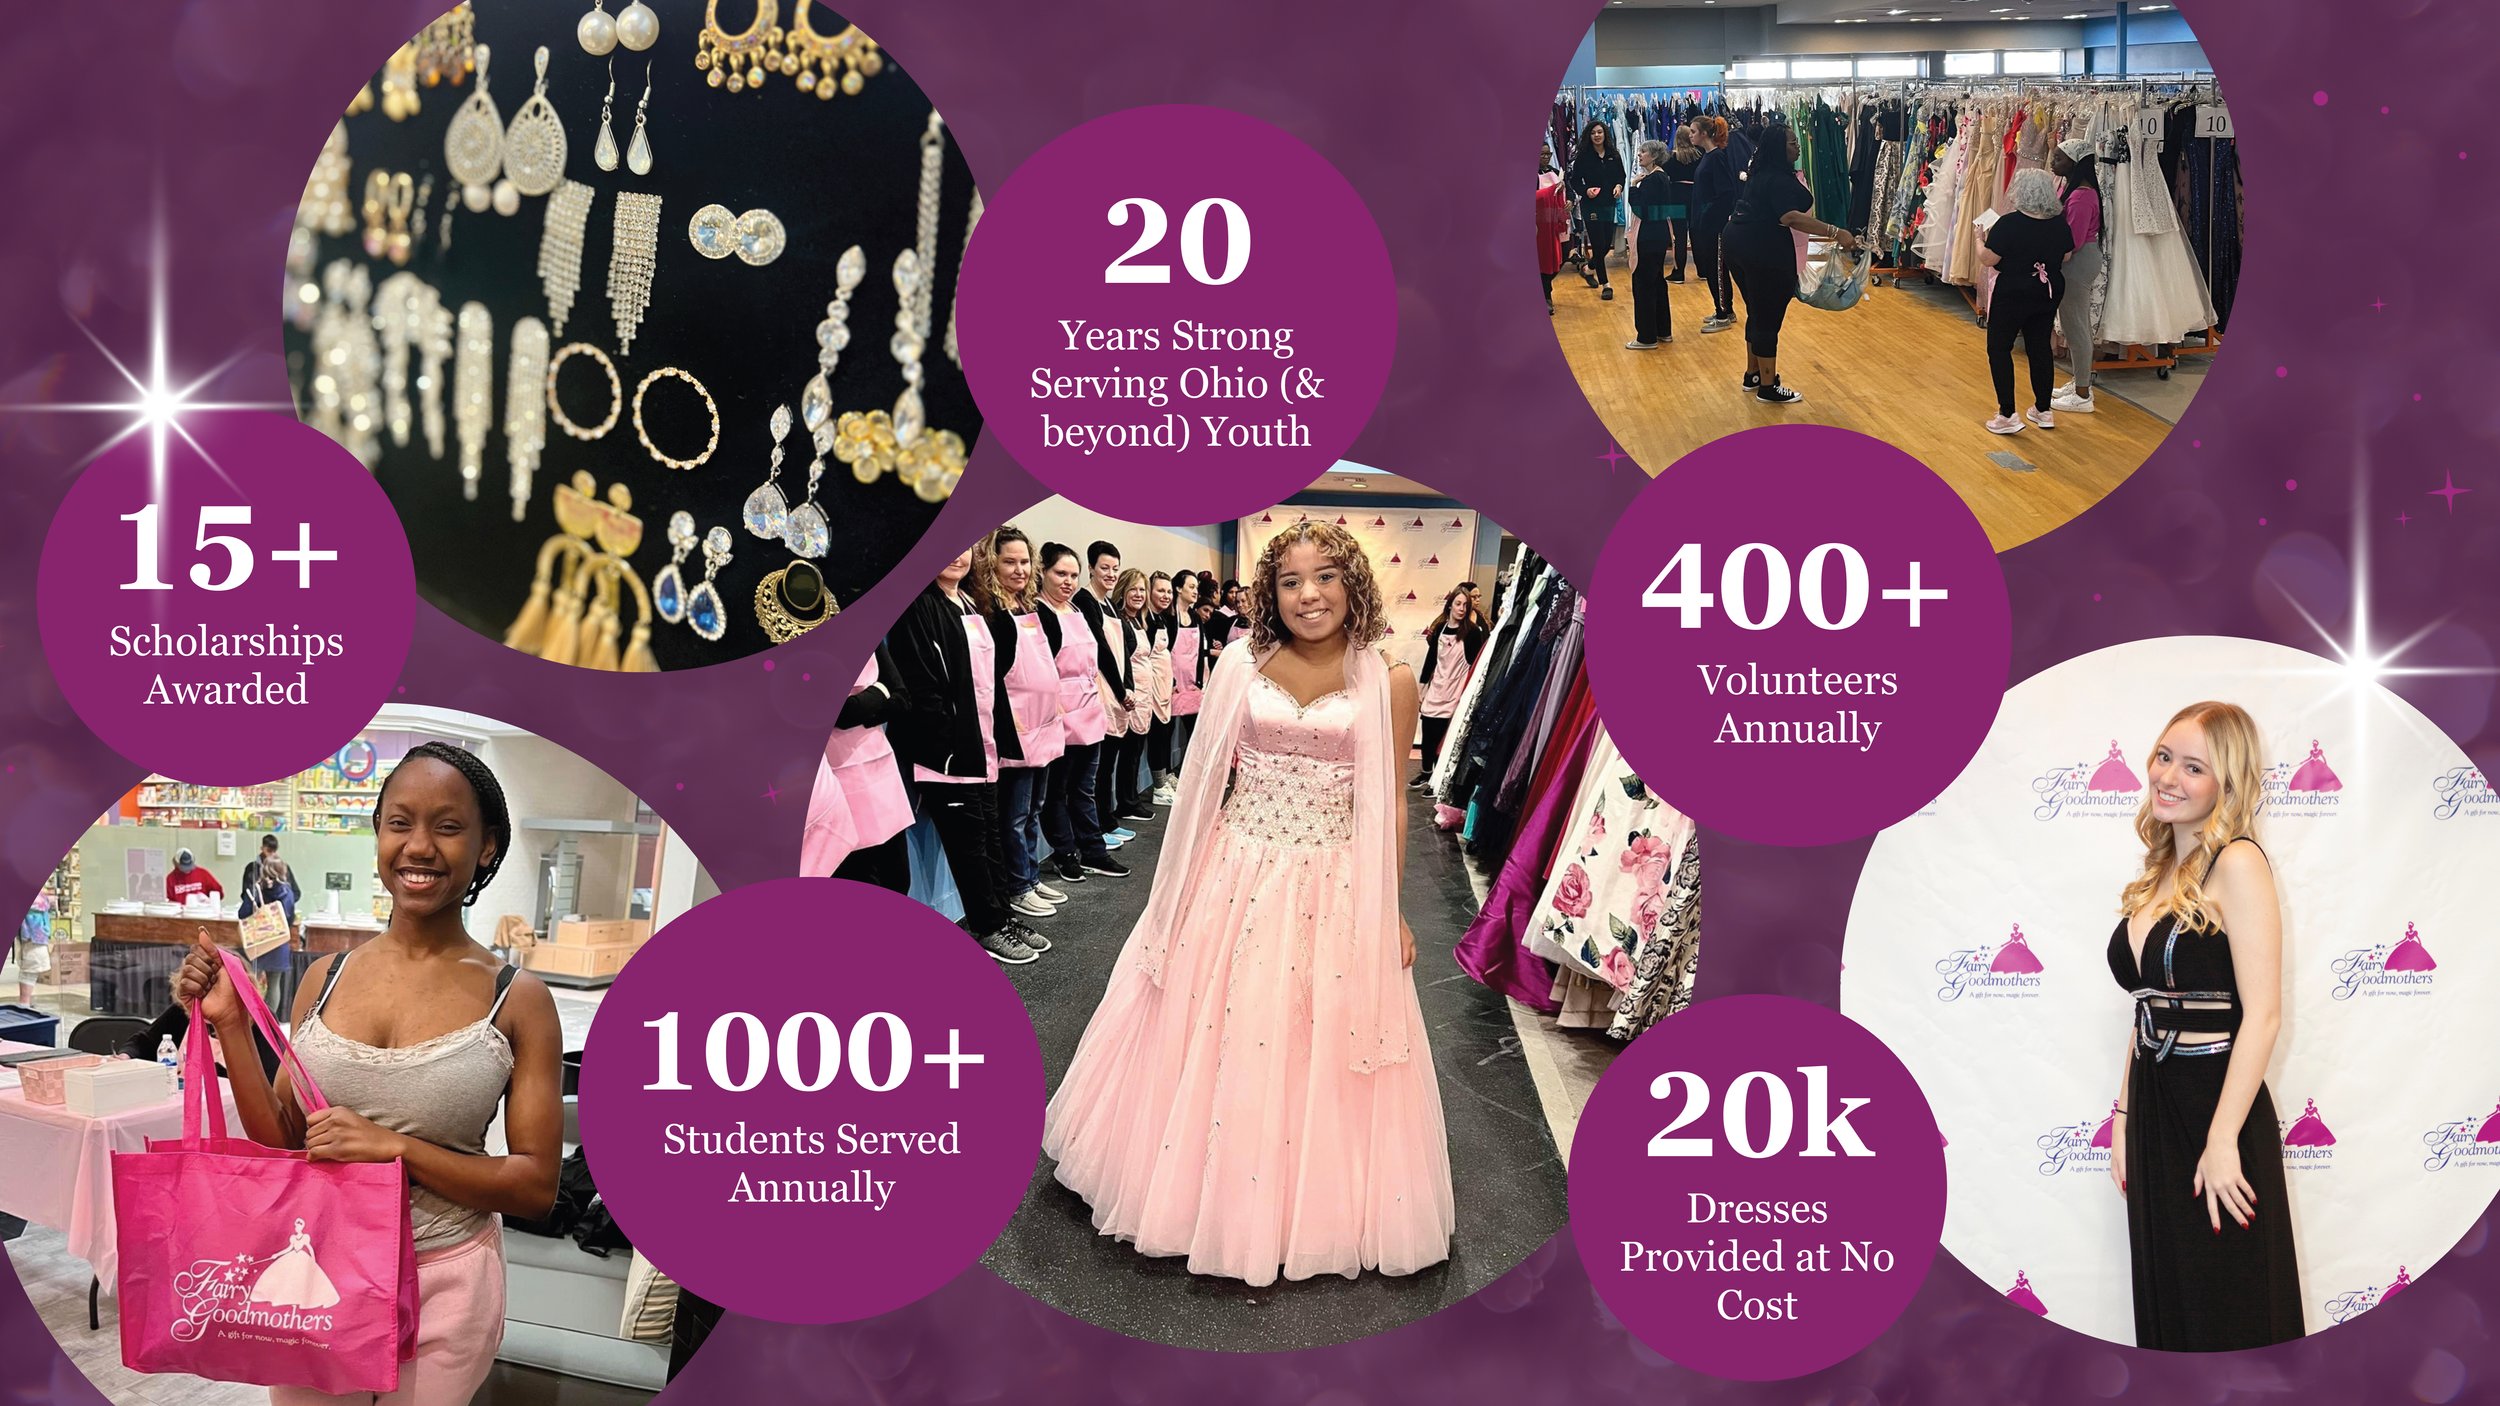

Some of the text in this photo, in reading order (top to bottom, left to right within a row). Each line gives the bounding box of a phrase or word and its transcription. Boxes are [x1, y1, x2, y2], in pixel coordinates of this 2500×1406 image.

[2206, 115, 2227, 133] 10
[2032, 767, 2088, 793] Fairy
[2433, 766, 2487, 792] Fairy
[2034, 789, 2139, 821] Goodmothers
[1935, 950, 1990, 976] Fairy
[2331, 949, 2384, 974] Fairy
[1938, 971, 2041, 1002] Goodmothers
[2332, 970, 2433, 1001] Goodmothers
[2037, 1126, 2091, 1150] Fairy
[2423, 1121, 2476, 1146] Fairy
[173, 1258, 252, 1305] Fairy
[170, 1293, 334, 1342] Goodmothers
[217, 1330, 226, 1339] A
[228, 1330, 240, 1340] gift
[241, 1332, 253, 1340] for
[276, 1336, 300, 1346] magic
